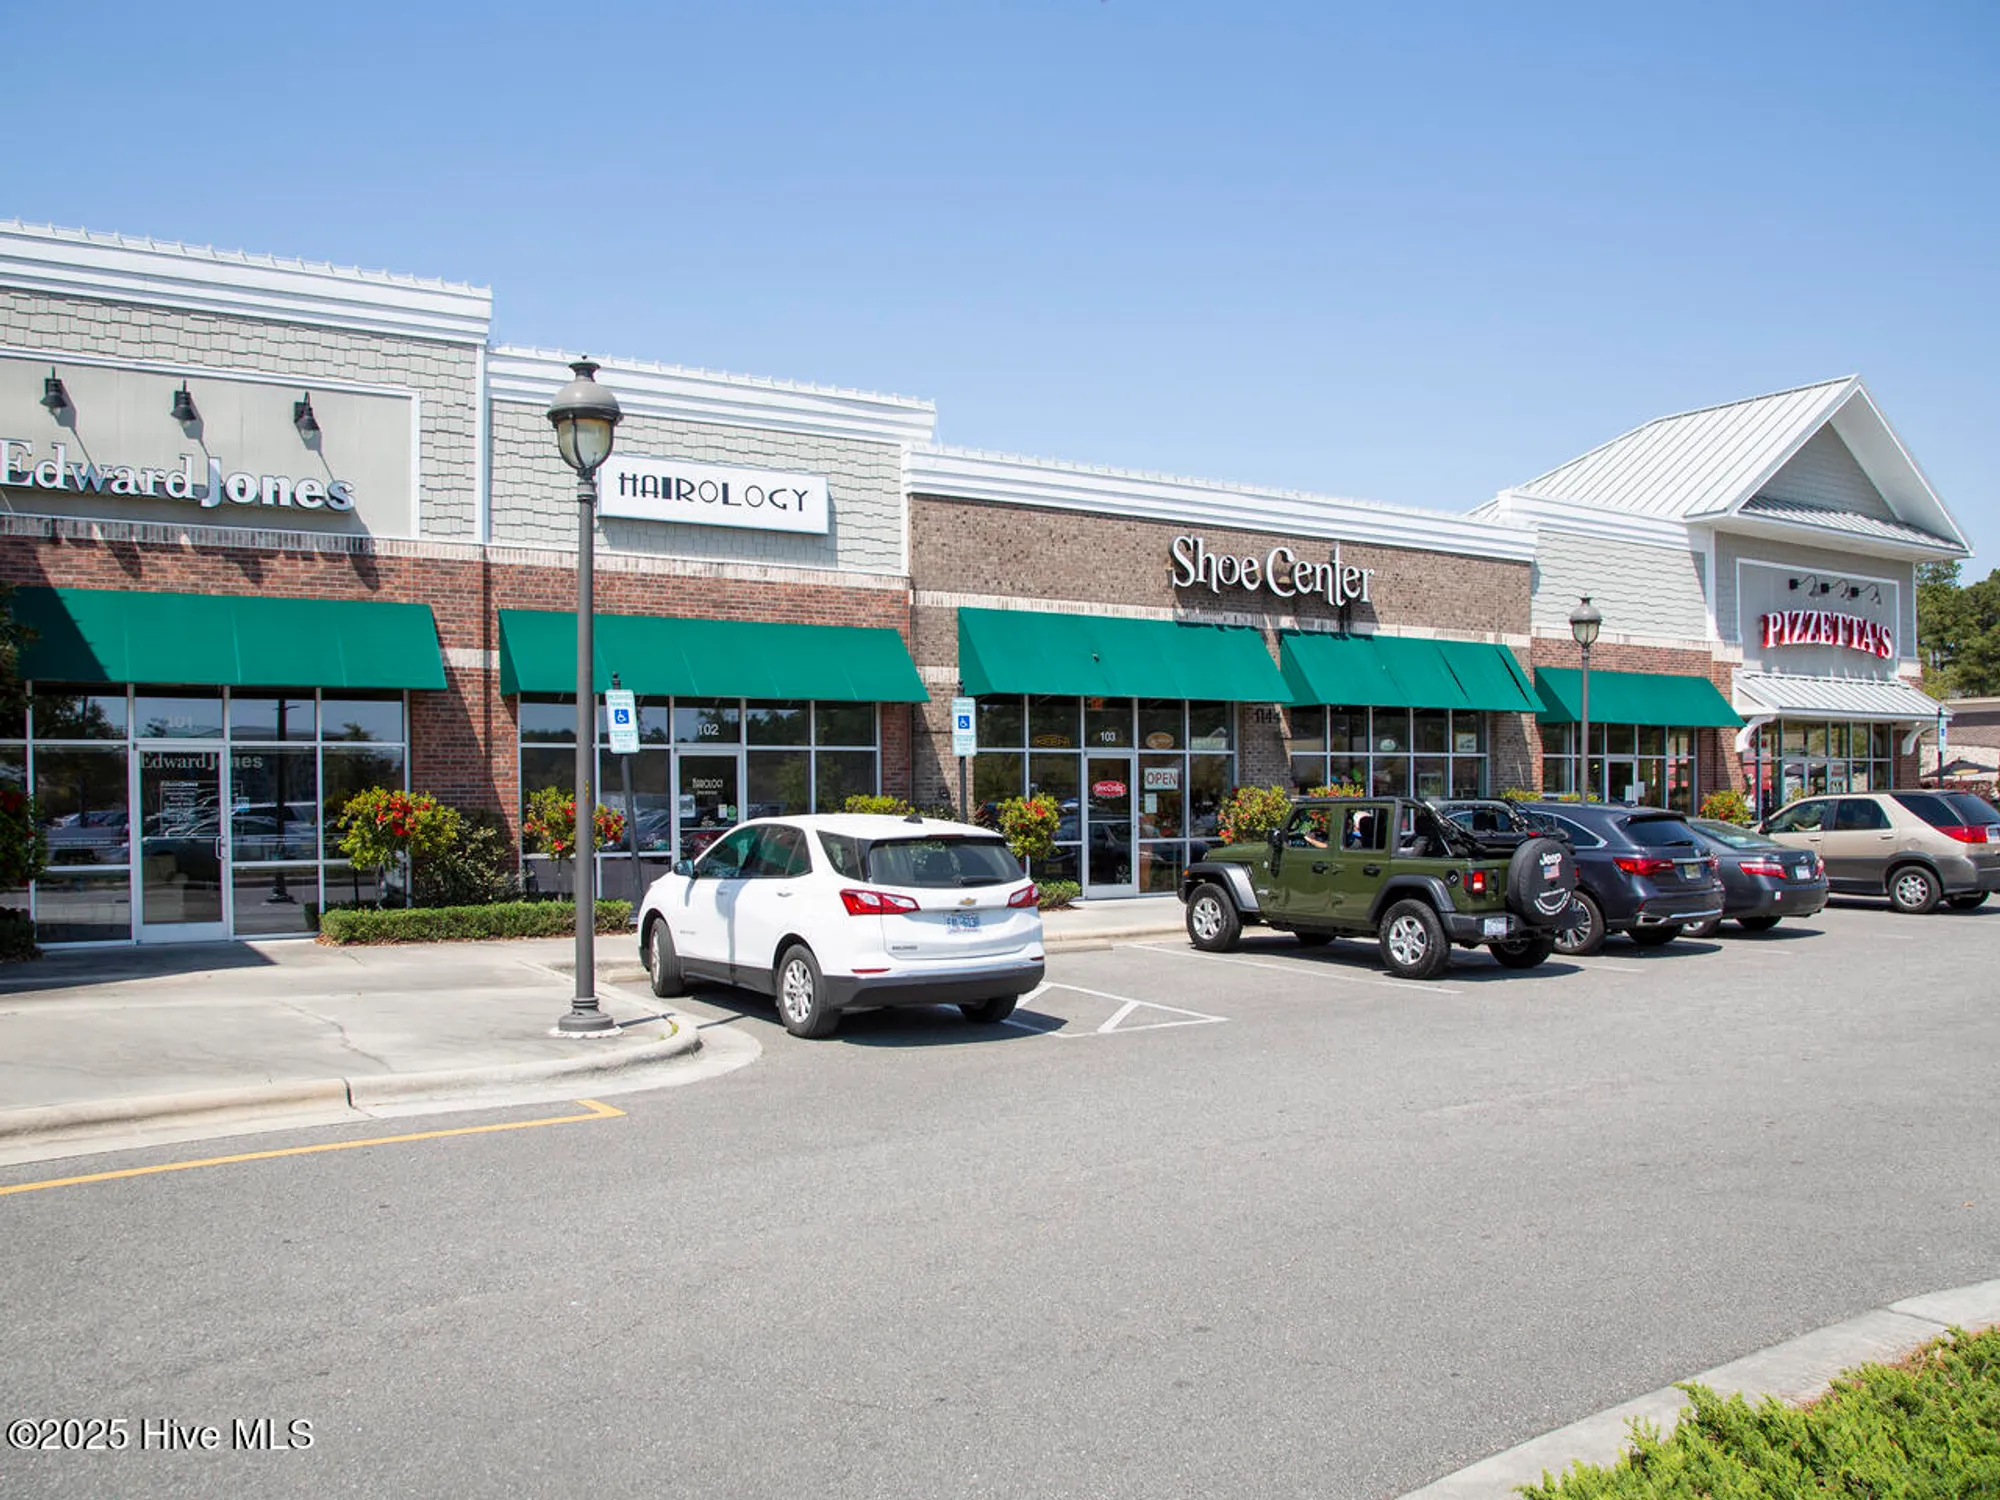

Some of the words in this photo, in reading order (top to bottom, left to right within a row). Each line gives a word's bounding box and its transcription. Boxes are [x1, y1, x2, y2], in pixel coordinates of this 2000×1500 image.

[0, 438, 197, 500] Edward
[200, 456, 355, 512] Jones
[619, 472, 809, 512] HAIROLOGY
[1169, 534, 1262, 594] Shoe
[1265, 540, 1375, 608] Center
[1761, 609, 1894, 660] PIZZETTA'S
[698, 724, 720, 736] 102
[1100, 730, 1116, 742] 103
[141, 751, 206, 769] Edward
[208, 753, 263, 770] Jnes
[1146, 772, 1177, 785] OPEN
[1539, 853, 1562, 866] Jeep
